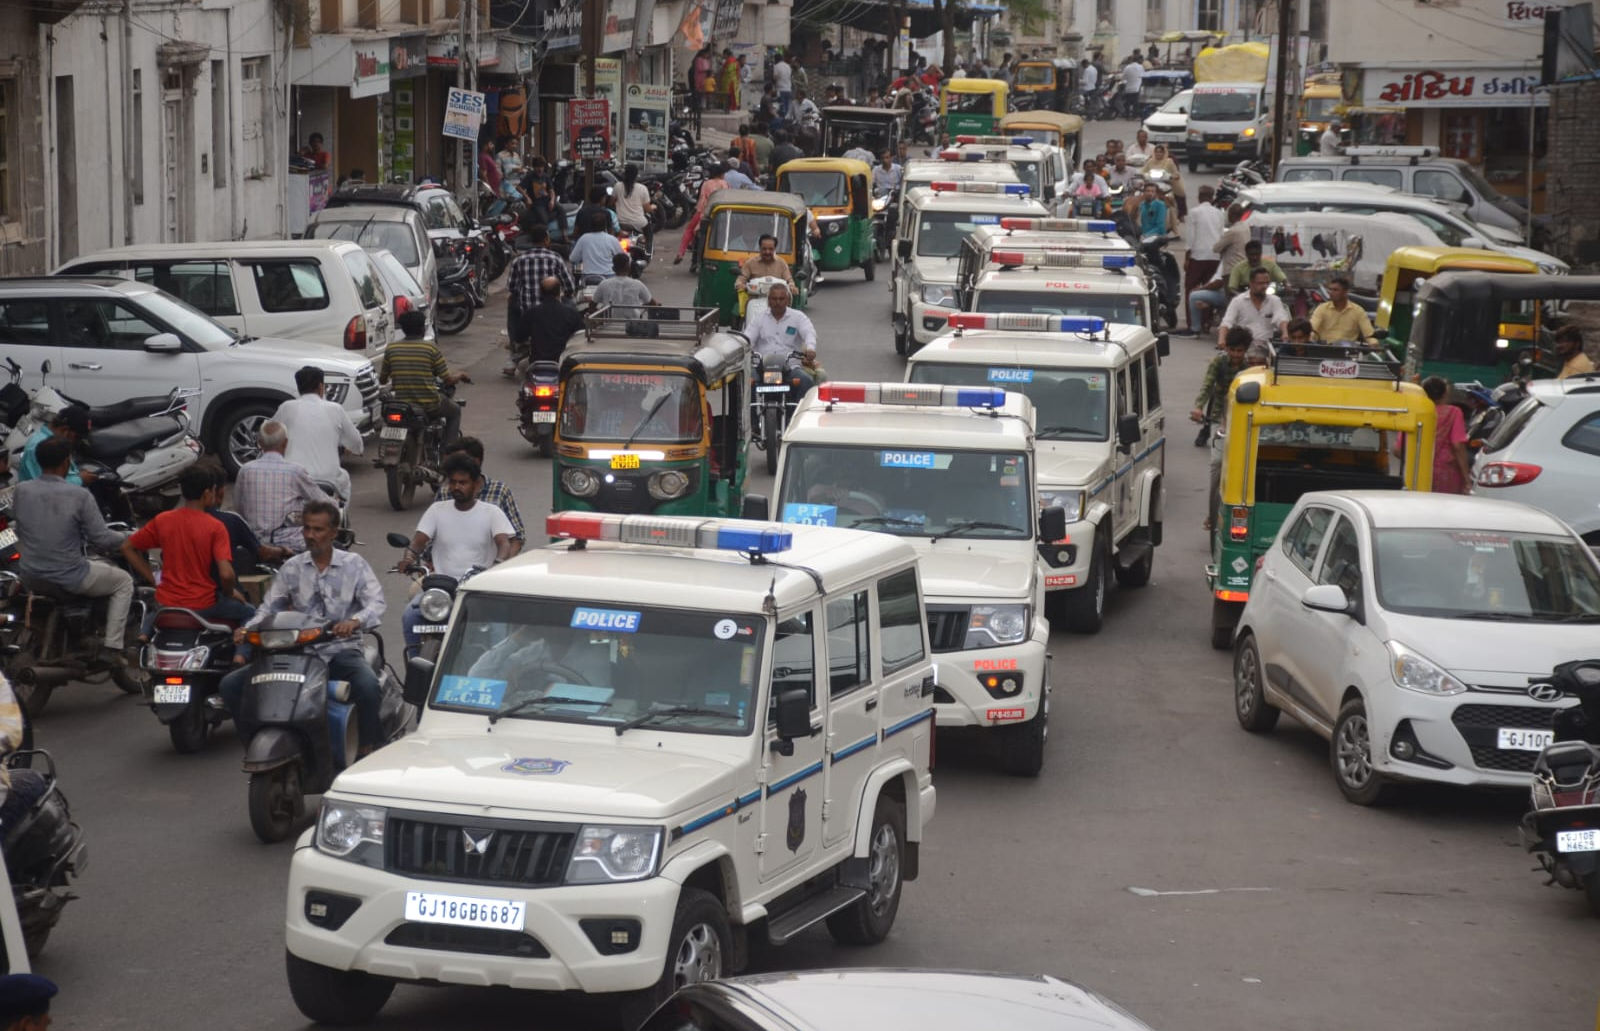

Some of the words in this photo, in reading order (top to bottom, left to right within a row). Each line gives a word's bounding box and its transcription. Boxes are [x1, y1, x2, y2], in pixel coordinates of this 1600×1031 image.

[1379, 70, 1475, 103] સંદિપ
[450, 91, 482, 107] SES
[449, 102, 481, 114] SCHOOLS
[990, 370, 1031, 381] POLICE
[884, 452, 931, 466] POLICE
[574, 610, 637, 629] POLICE
[974, 659, 1018, 670] POLICE
[443, 689, 496, 706] L.C.B.
[418, 898, 520, 925] GJ18GB6687
